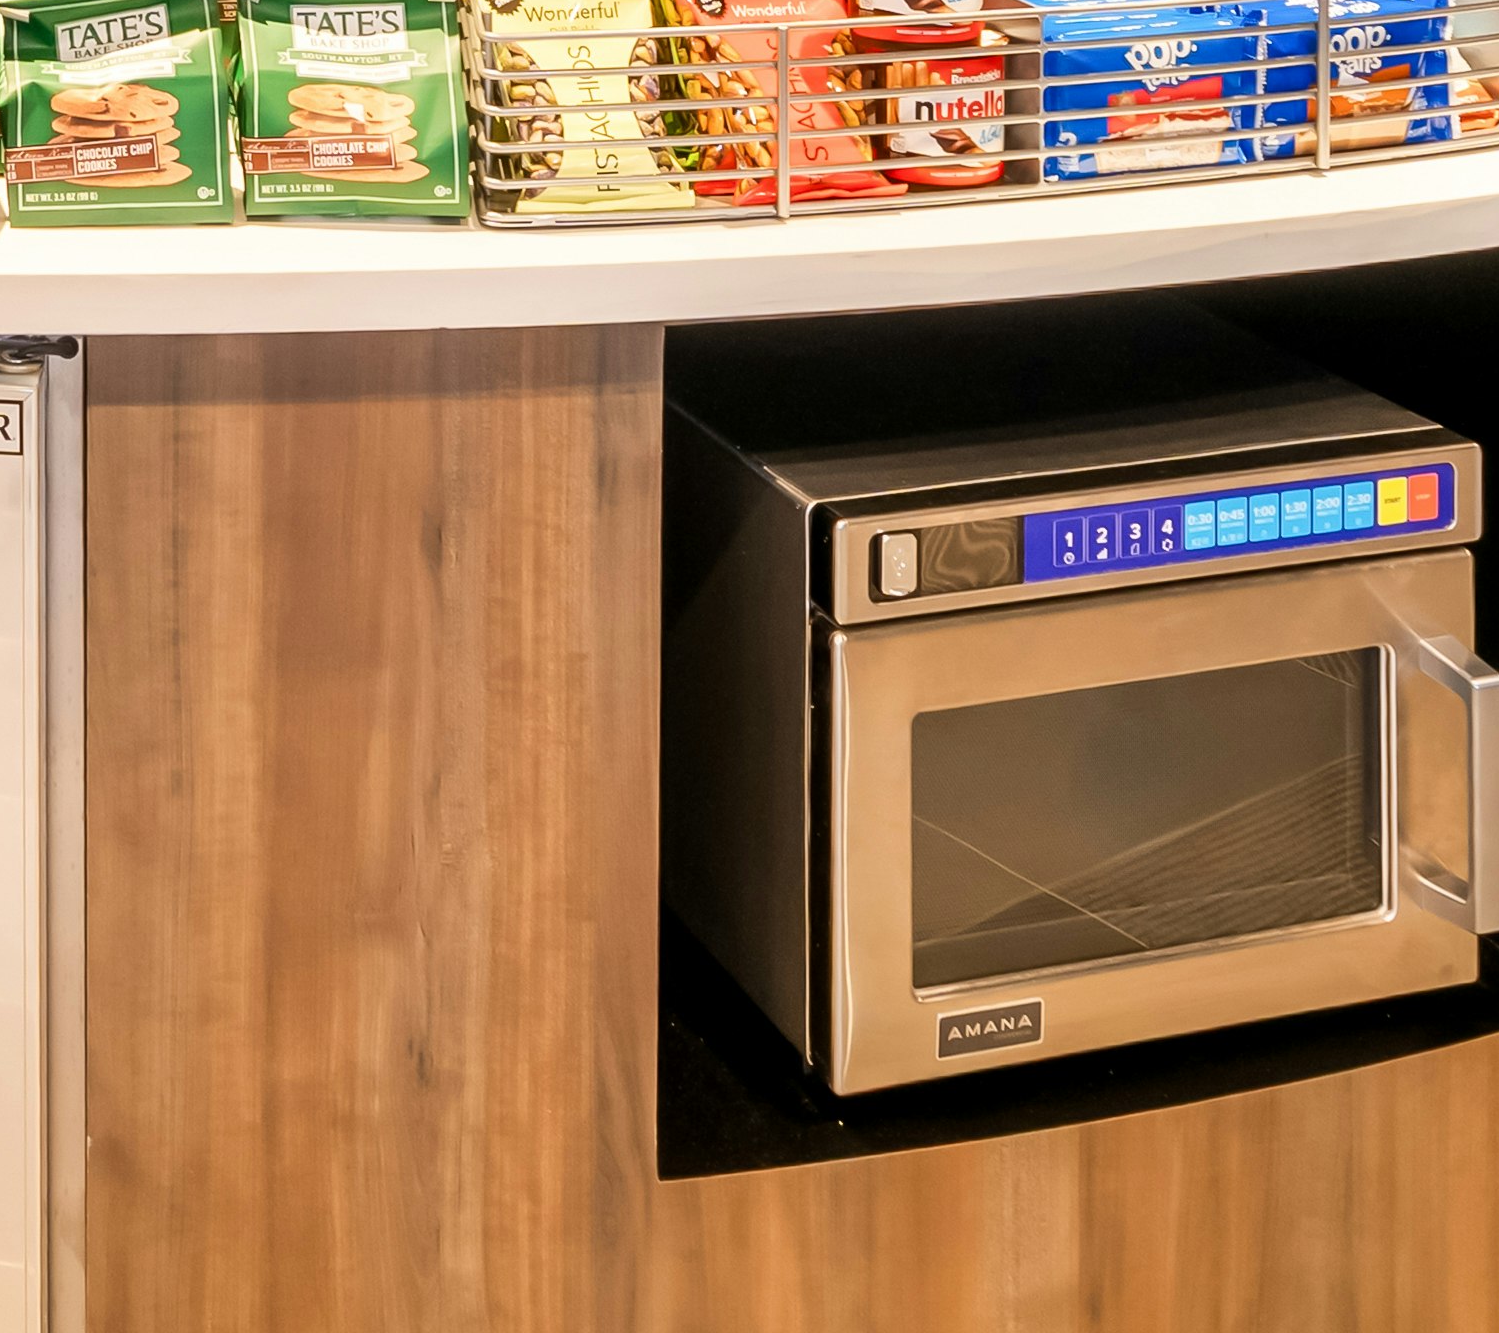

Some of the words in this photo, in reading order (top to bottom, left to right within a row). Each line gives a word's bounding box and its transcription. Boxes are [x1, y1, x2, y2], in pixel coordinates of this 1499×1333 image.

[523, 1, 620, 23] Wonderful
[730, 1, 807, 19] Wonderful
[60, 10, 165, 50] TATE'S
[296, 9, 400, 38] TATE'S
[309, 37, 345, 49] BAKE
[351, 38, 390, 49] SHOP
[73, 45, 111, 60] BAKE
[914, 89, 1004, 122] nutella
[76, 144, 129, 161] CHOCOLATE
[130, 142, 154, 155] CHIP
[312, 141, 365, 155] CHOCOLATE
[366, 141, 390, 154] CHIP
[77, 159, 118, 173] COOKIES
[313, 154, 354, 168] COOKIES
[25, 193, 39, 202] NET
[54, 192, 65, 202] 3.5
[66, 192, 76, 201] OZ
[261, 184, 275, 194] NET
[1064, 532, 1074, 547] 1
[1096, 528, 1108, 544] 2
[1129, 523, 1142, 540] 3
[1160, 519, 1174, 535] 4
[1187, 512, 1213, 526] 0:30
[1219, 509, 1245, 522] 0:45
[1253, 505, 1276, 517] 1:00
[1284, 501, 1308, 514] 1:30
[1315, 497, 1341, 510] 2:00
[1347, 492, 1372, 506] 2:30
[947, 1014, 1033, 1042] AMANA
